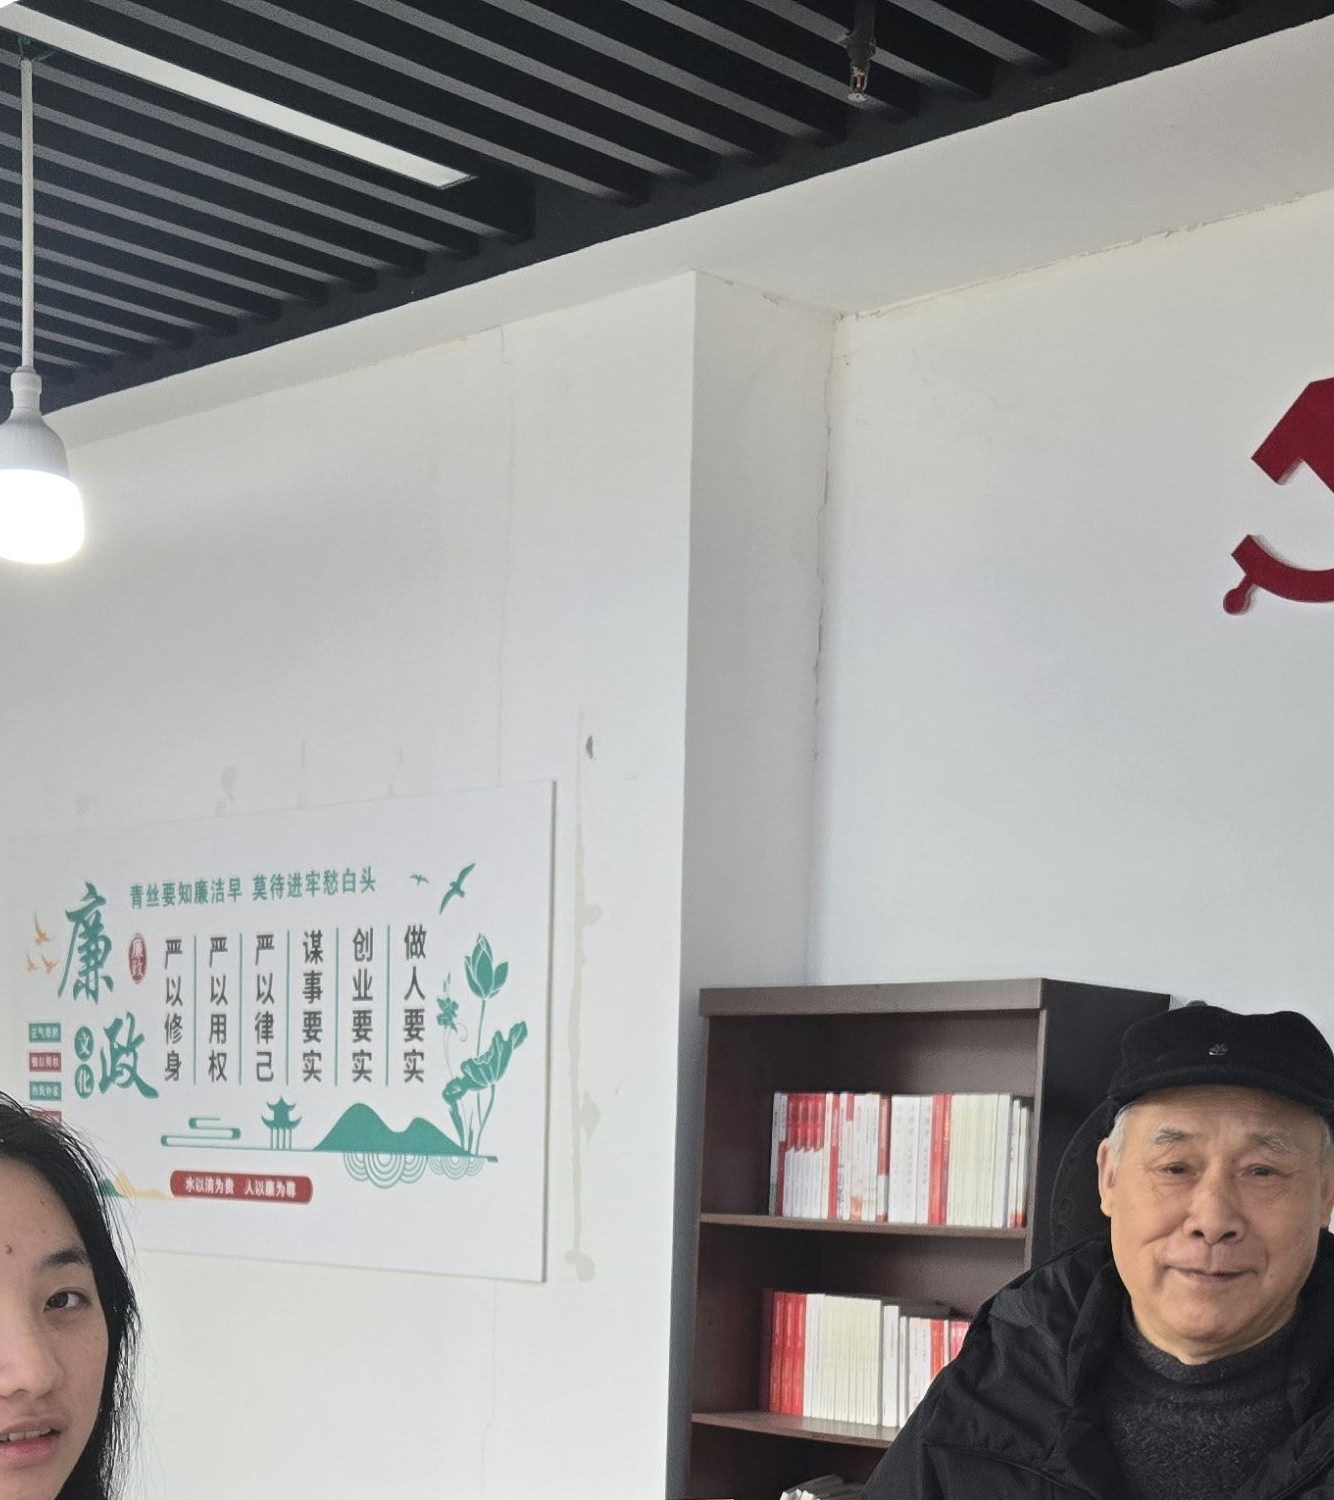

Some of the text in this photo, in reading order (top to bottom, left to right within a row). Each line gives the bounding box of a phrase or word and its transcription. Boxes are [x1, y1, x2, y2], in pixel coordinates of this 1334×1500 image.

[129, 867, 378, 910] 青丝要知廉洁早 莫待进牢愁白头
[76, 1032, 93, 1095] 文化
[163, 935, 185, 1083] 严以修身
[207, 933, 229, 1083] 严以用权
[253, 931, 276, 1083] 严以律己
[302, 928, 324, 1084] 谋事要实
[352, 926, 374, 1084] 创业要实
[403, 923, 427, 1084] 做人要实
